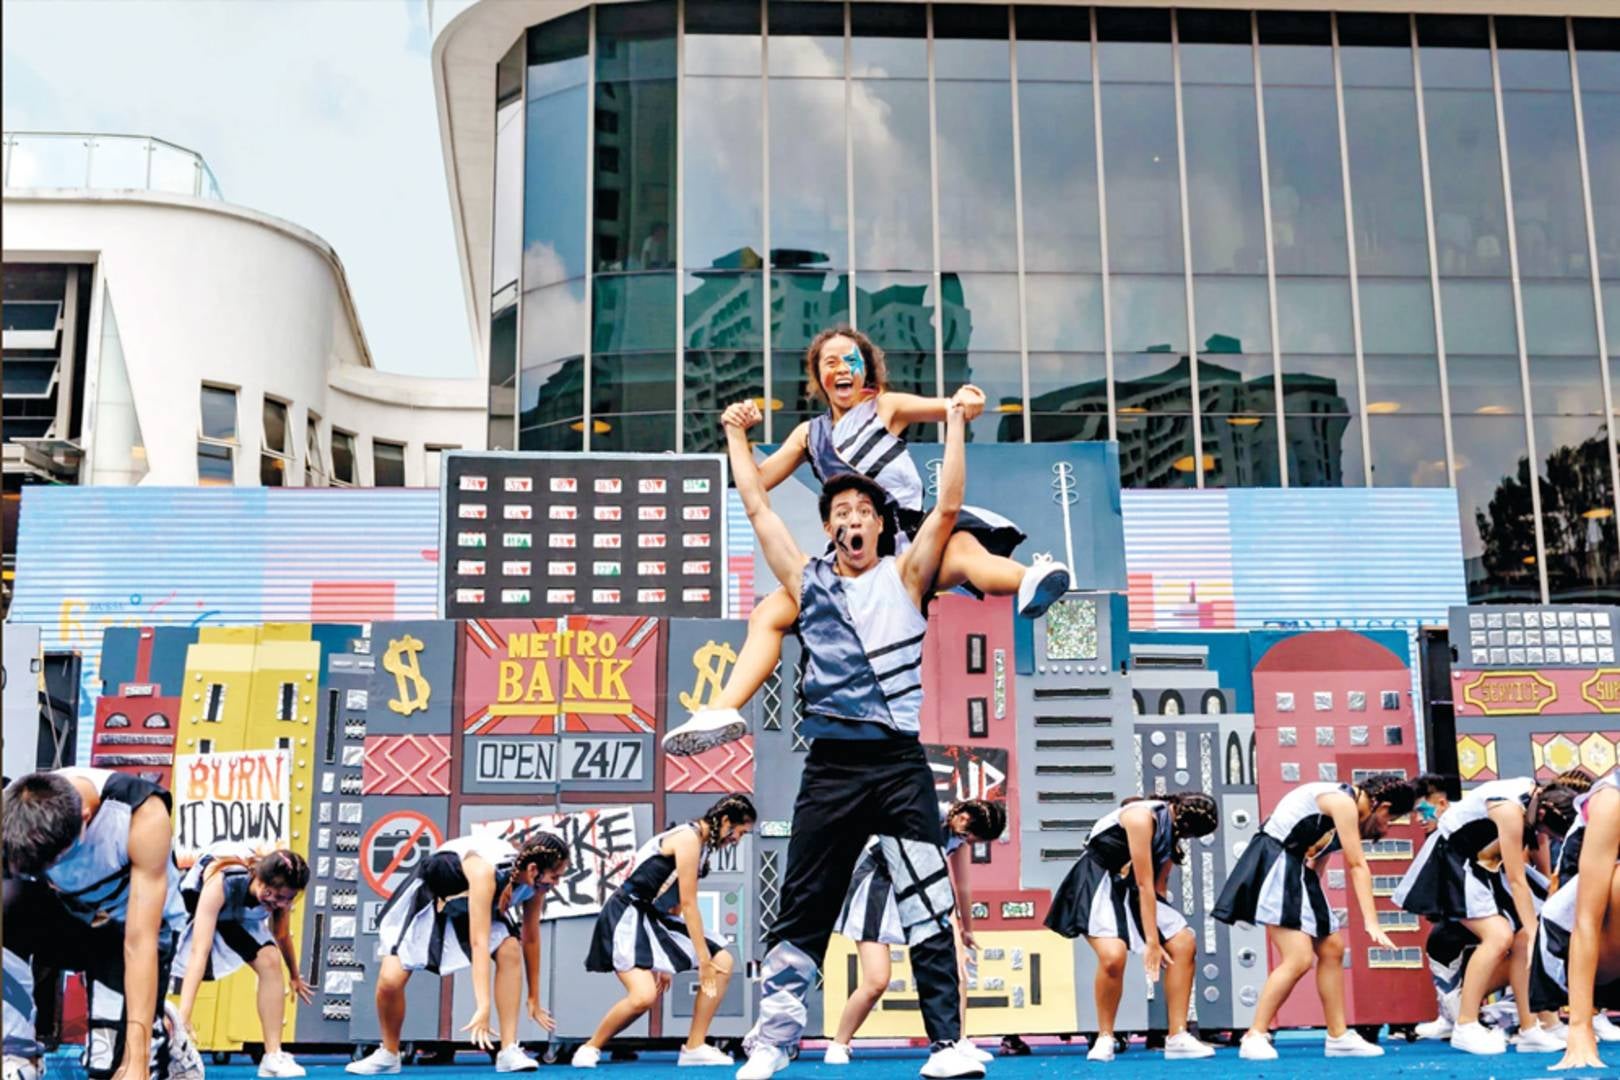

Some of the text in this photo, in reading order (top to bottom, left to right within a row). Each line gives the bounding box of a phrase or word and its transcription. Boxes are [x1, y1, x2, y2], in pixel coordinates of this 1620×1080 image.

[497, 657, 633, 702] BANK
[187, 754, 283, 800] BURN
[480, 741, 641, 779] OPEN 24/7
[178, 800, 284, 849] IT DOWN
